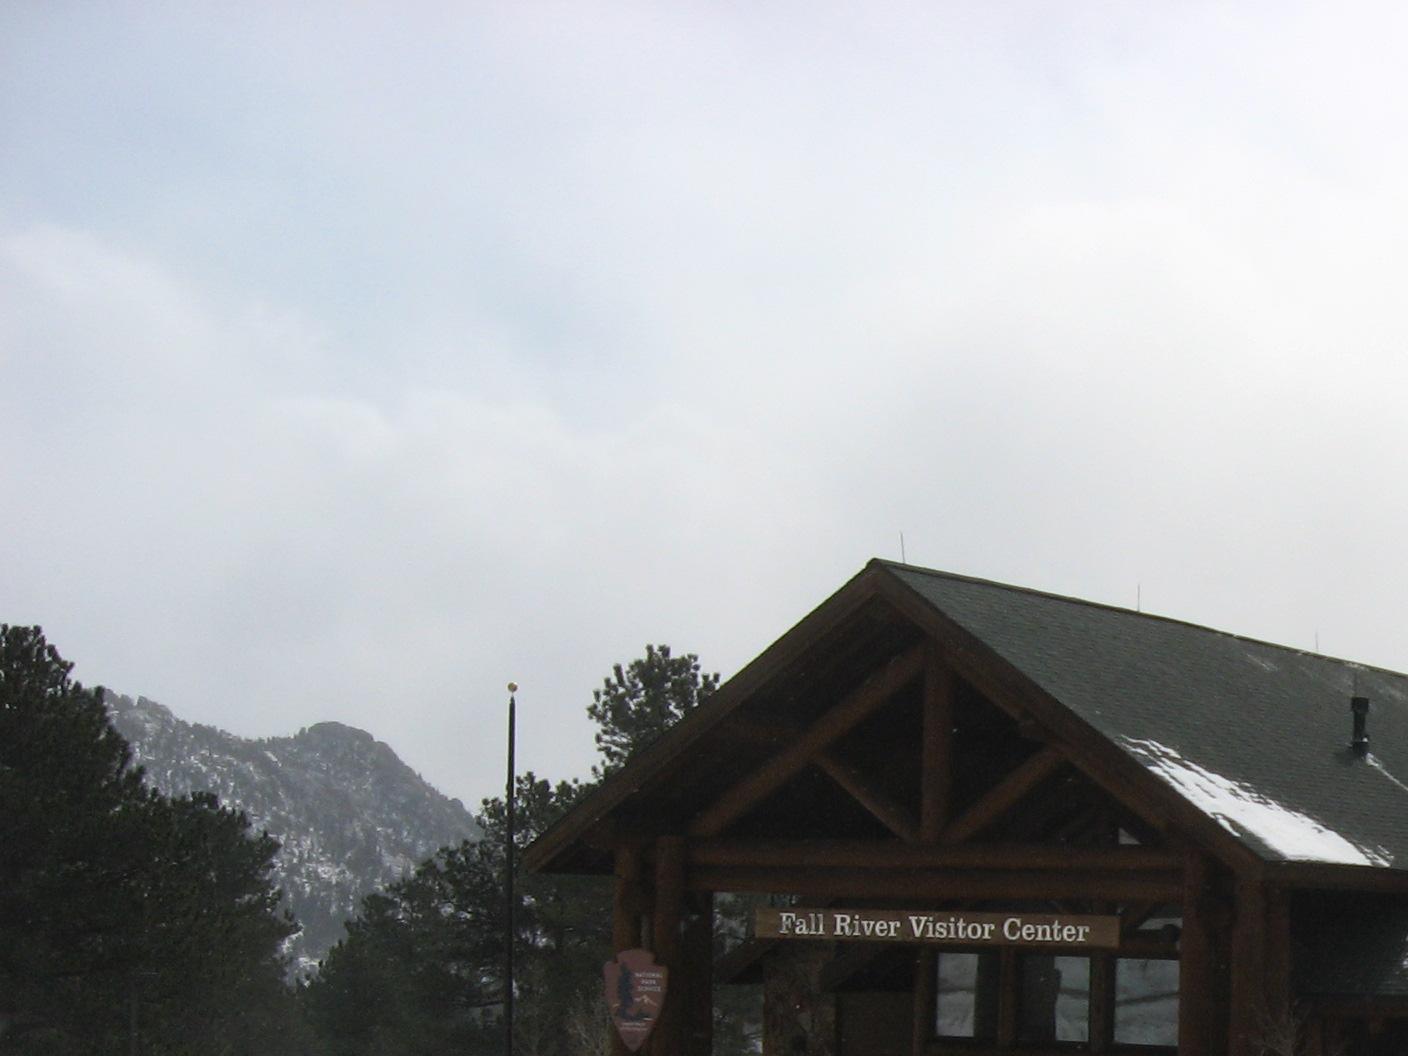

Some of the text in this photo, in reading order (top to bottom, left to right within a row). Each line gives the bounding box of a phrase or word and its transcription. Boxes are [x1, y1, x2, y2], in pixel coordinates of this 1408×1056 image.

[779, 912, 1090, 942] Fall River Visitor Center
